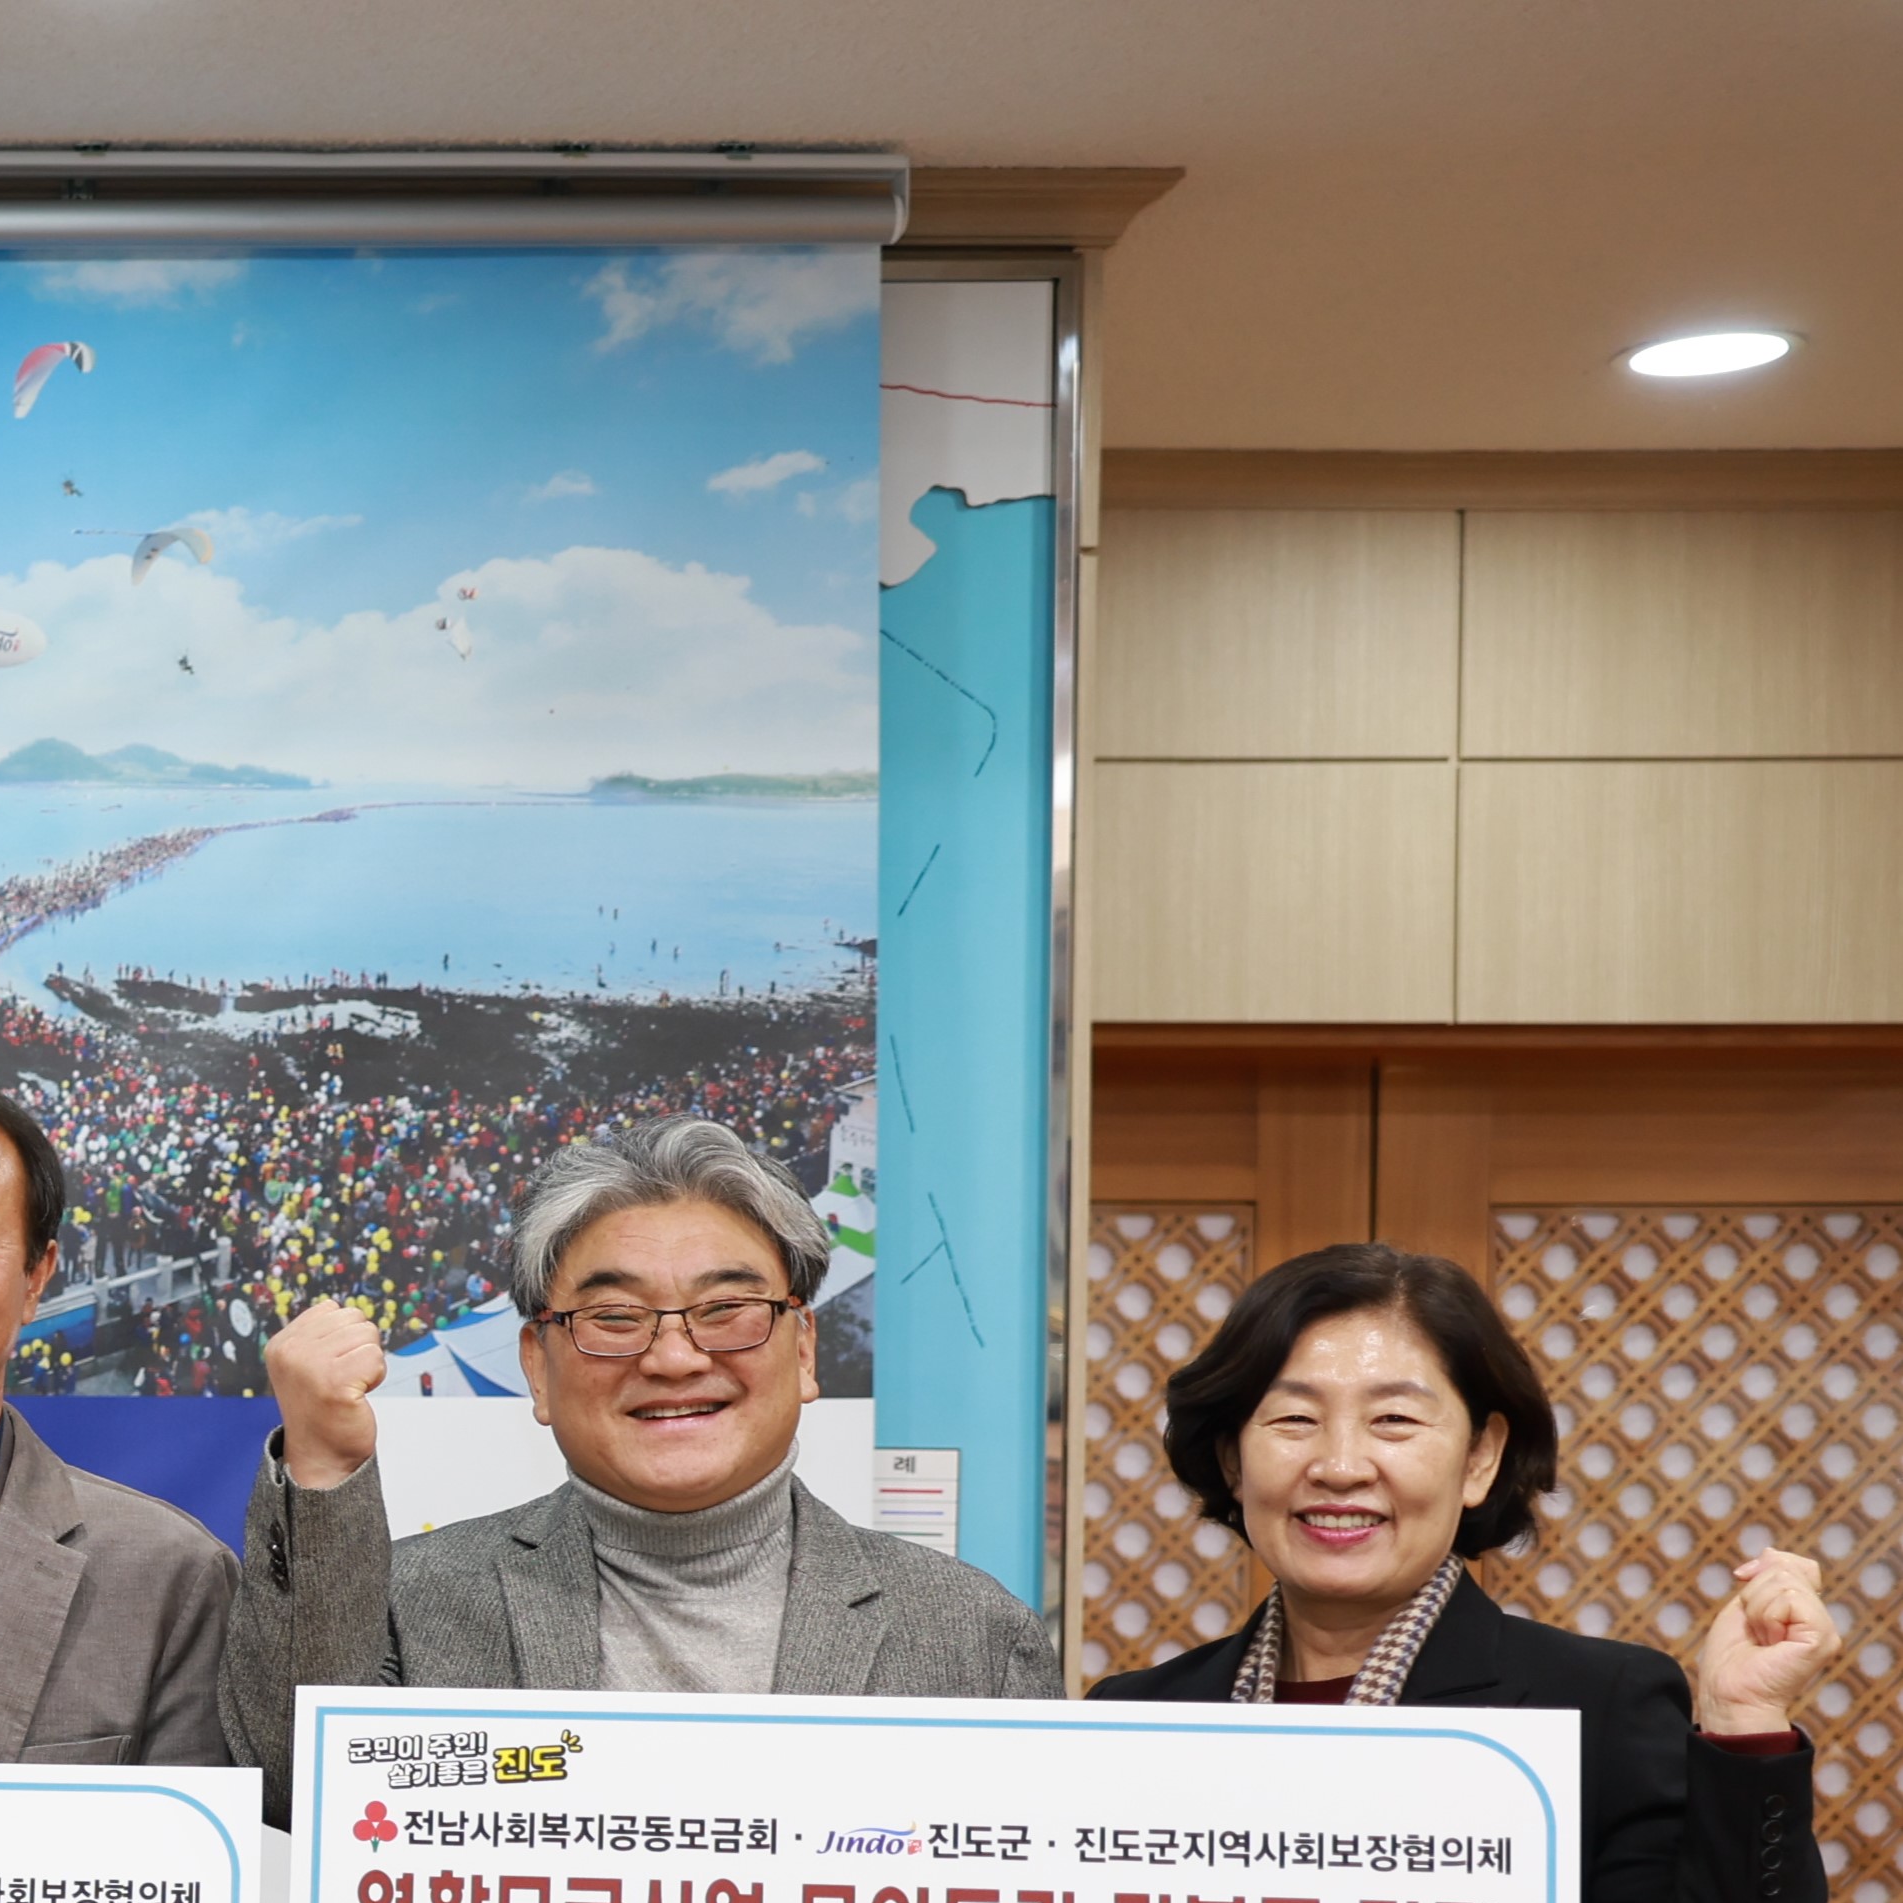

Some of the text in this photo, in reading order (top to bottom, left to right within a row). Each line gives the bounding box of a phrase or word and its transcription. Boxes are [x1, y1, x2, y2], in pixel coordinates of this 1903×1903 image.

[349, 1732, 487, 1763] 군민이 주인!
[386, 1744, 569, 1789] 살기좋은 진도
[405, 1810, 1510, 1874] 전남사회복지공동모금회 Jindo 진도군 진도군지역사회보장협의체
